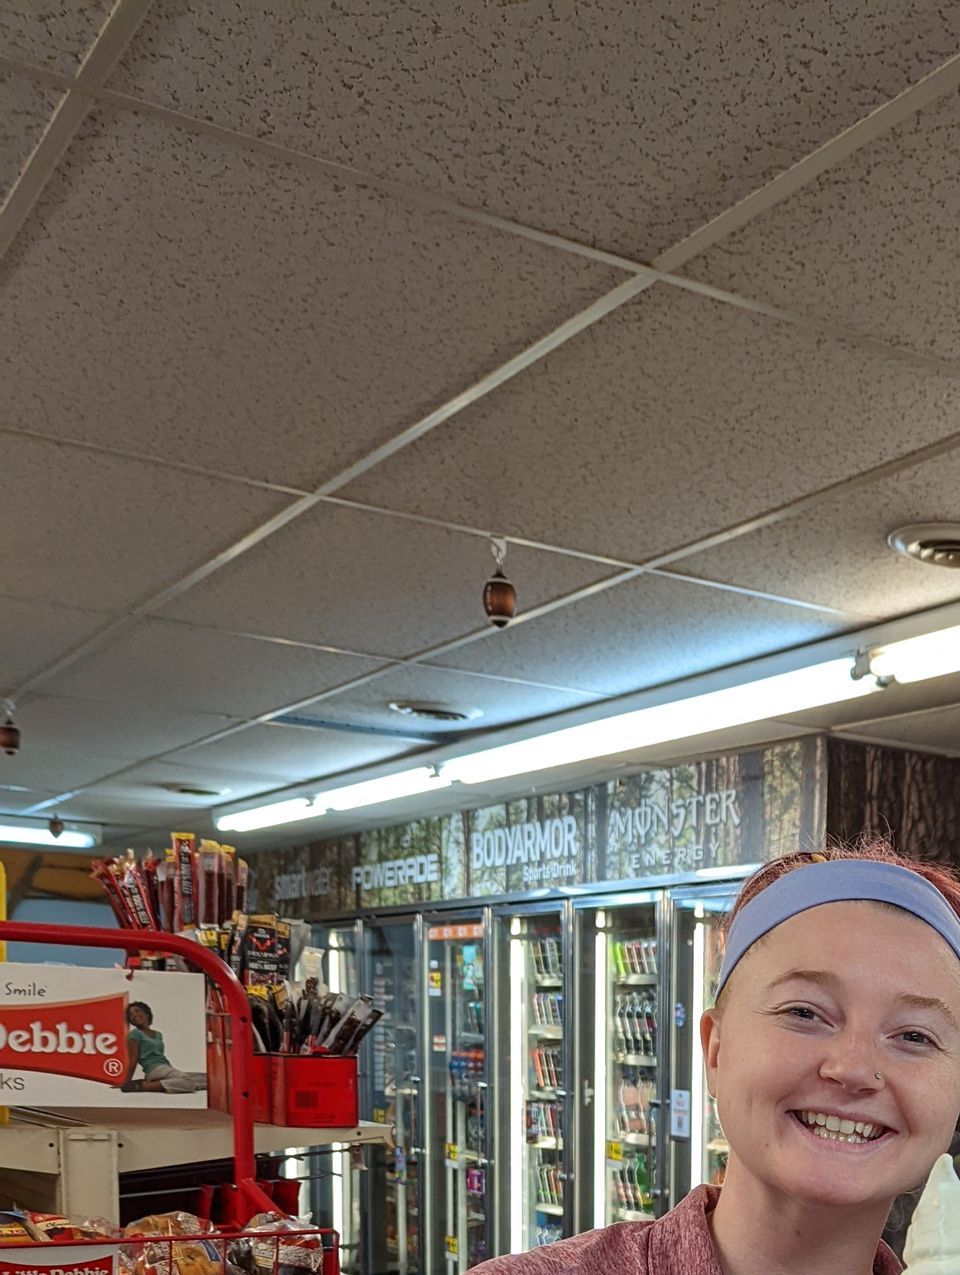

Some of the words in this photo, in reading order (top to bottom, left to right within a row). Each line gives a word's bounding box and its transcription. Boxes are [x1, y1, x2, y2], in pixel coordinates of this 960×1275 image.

[610, 790, 740, 845] MONSTER
[472, 815, 578, 869] BODYARMOR
[632, 842, 720, 869] ENERGY
[352, 853, 440, 891] POWERADE
[5, 982, 47, 997] Smile
